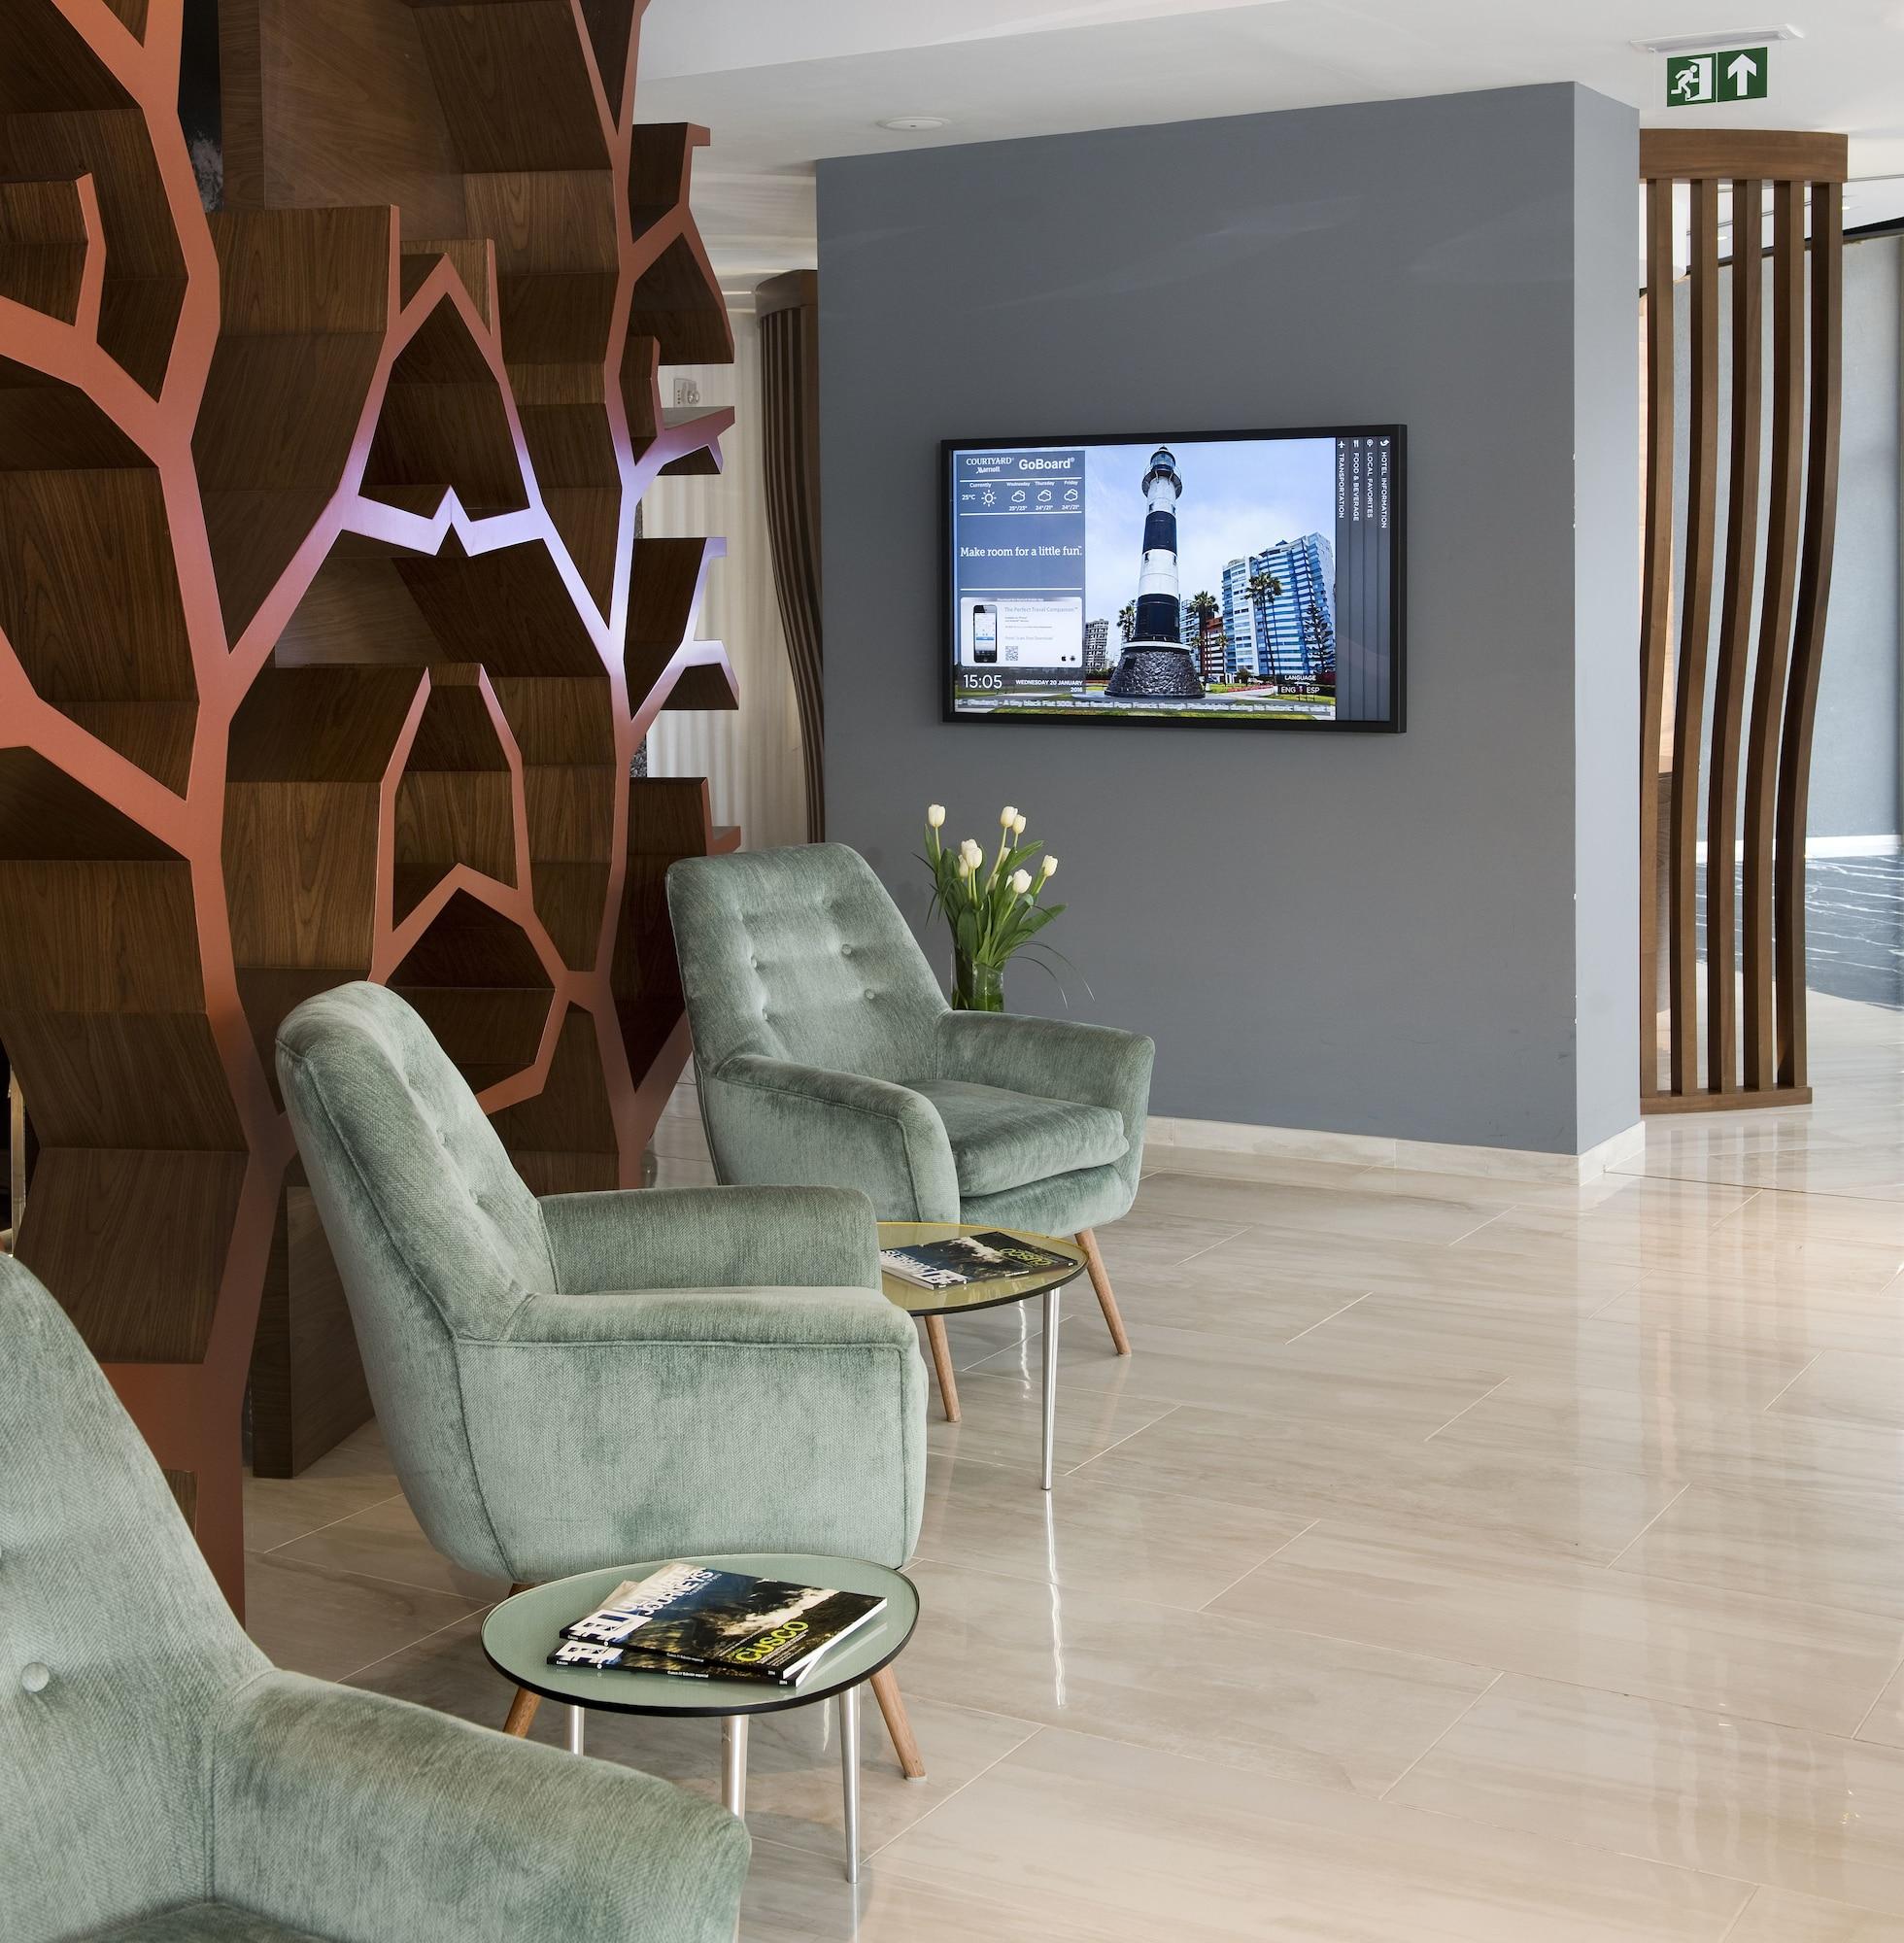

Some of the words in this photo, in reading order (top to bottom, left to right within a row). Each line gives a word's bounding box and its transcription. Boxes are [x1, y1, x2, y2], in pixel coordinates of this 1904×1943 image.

[960, 546, 985, 557] Make
[987, 548, 1013, 557] room
[1015, 545, 1030, 556] for
[1038, 546, 1061, 556] little
[963, 674, 1003, 689] 15:05
[1230, 703, 1253, 712] during
[1266, 703, 1293, 712] historic
[639, 1568, 715, 1616] JOURNEYS
[734, 1620, 809, 1662] CUSCO
